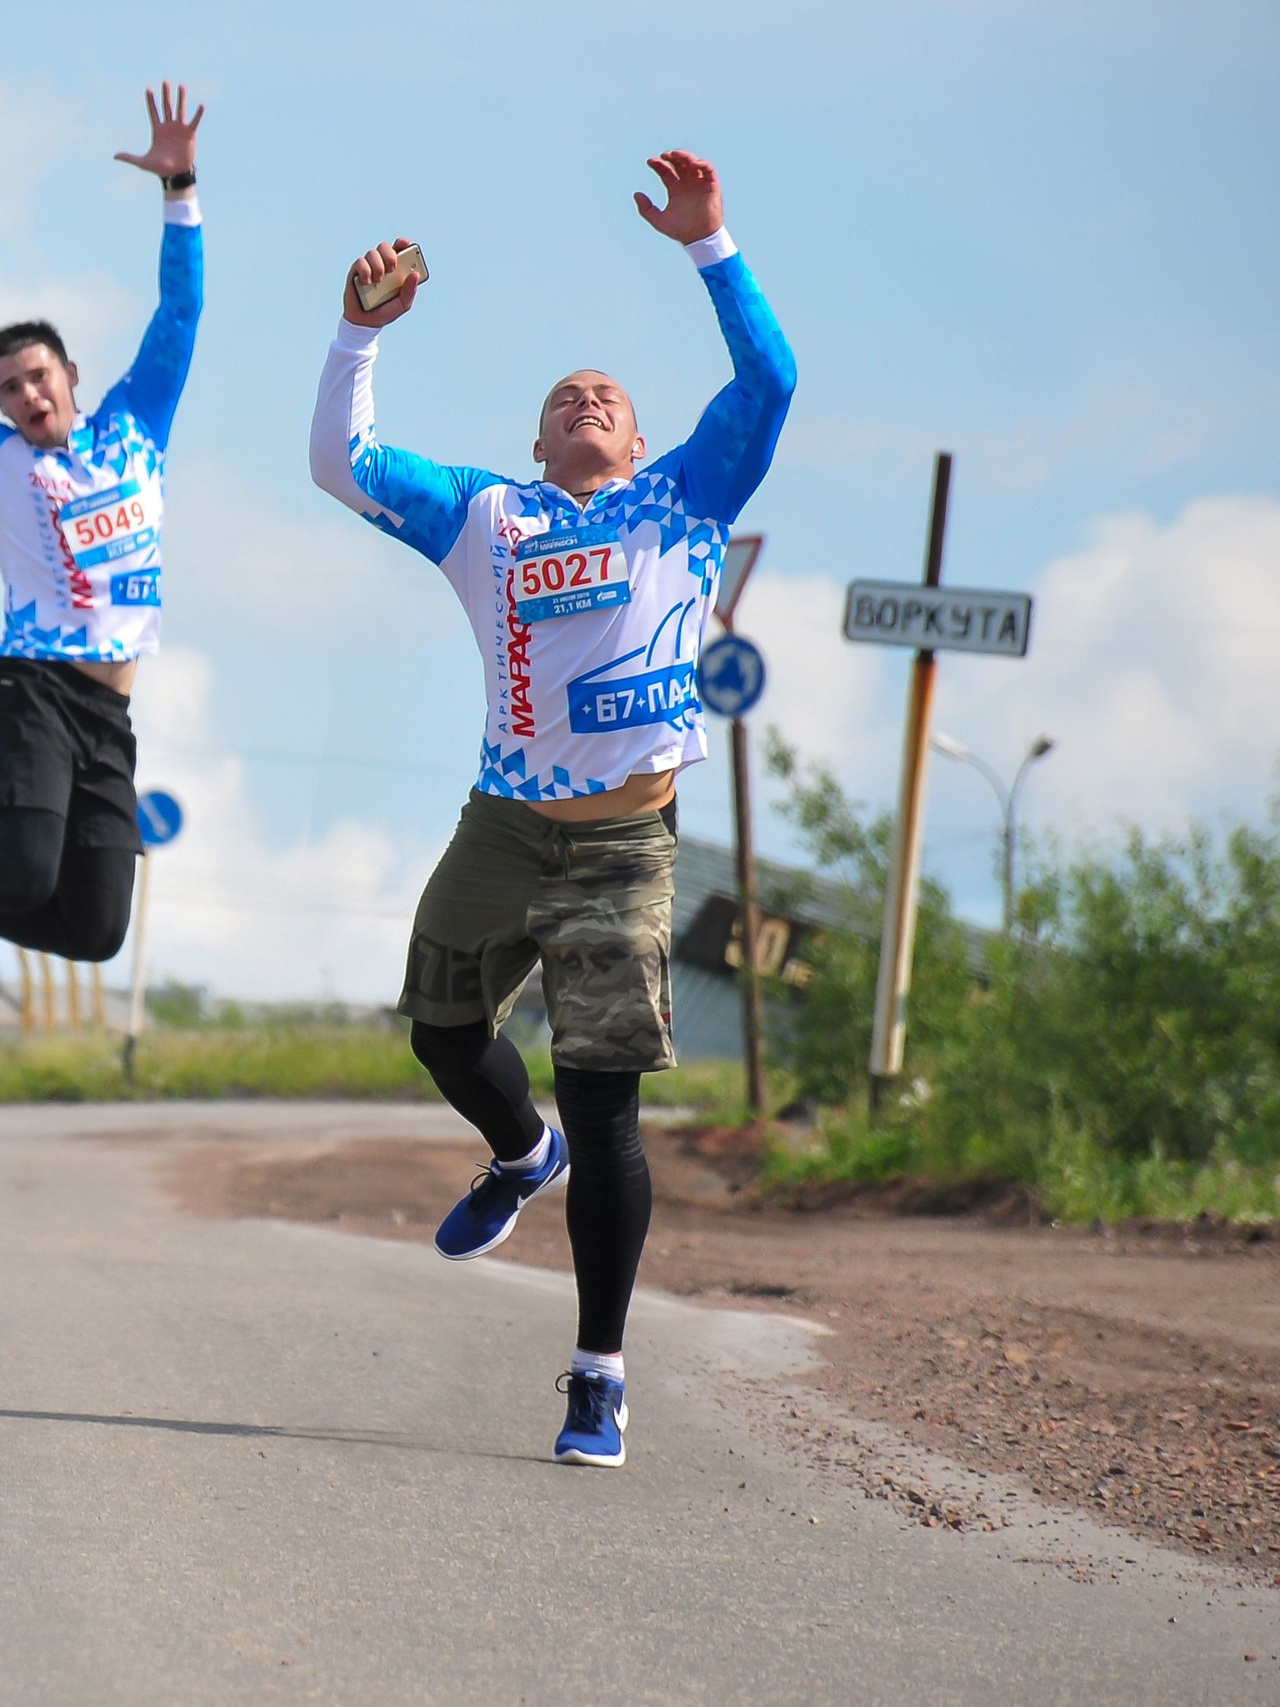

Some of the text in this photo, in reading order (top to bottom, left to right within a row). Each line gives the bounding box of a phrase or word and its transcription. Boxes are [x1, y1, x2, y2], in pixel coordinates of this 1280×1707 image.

[75, 501, 145, 545] 5049
[522, 546, 612, 596] 5027
[490, 543, 509, 735] АРКТИЧЕСКИЙ
[506, 547, 536, 739] МАРАФ
[854, 595, 1018, 644] ВОРКУТА
